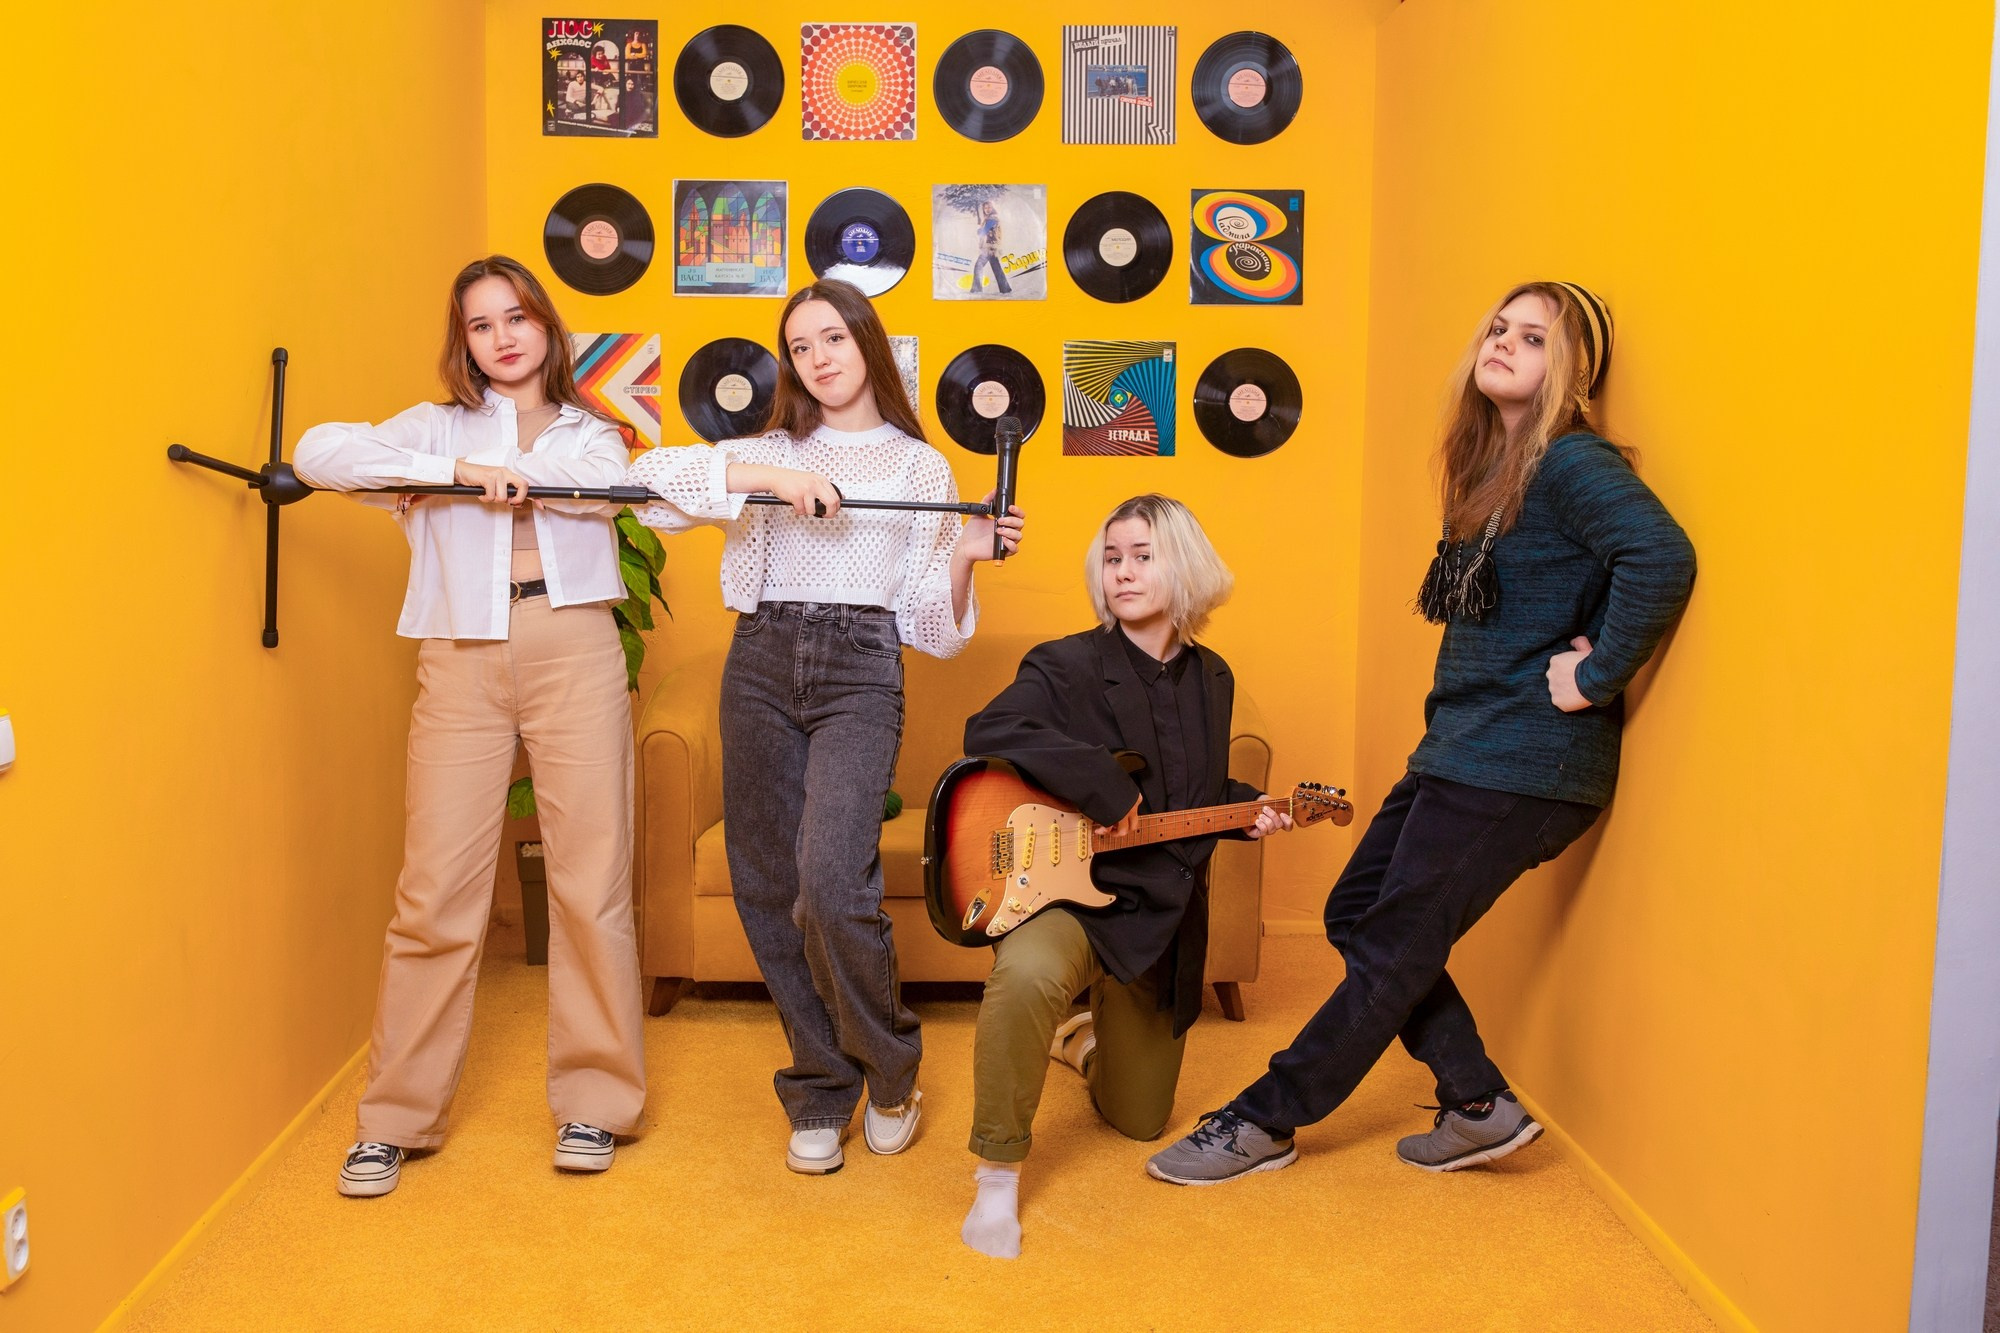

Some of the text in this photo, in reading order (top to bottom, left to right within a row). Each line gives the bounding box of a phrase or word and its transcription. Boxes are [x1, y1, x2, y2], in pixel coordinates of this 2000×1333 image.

[548, 20, 592, 39] ЛОС
[845, 226, 875, 239] МЕЛОДИЯ
[681, 274, 704, 282] BACH
[623, 386, 658, 394] СТЕРЕО
